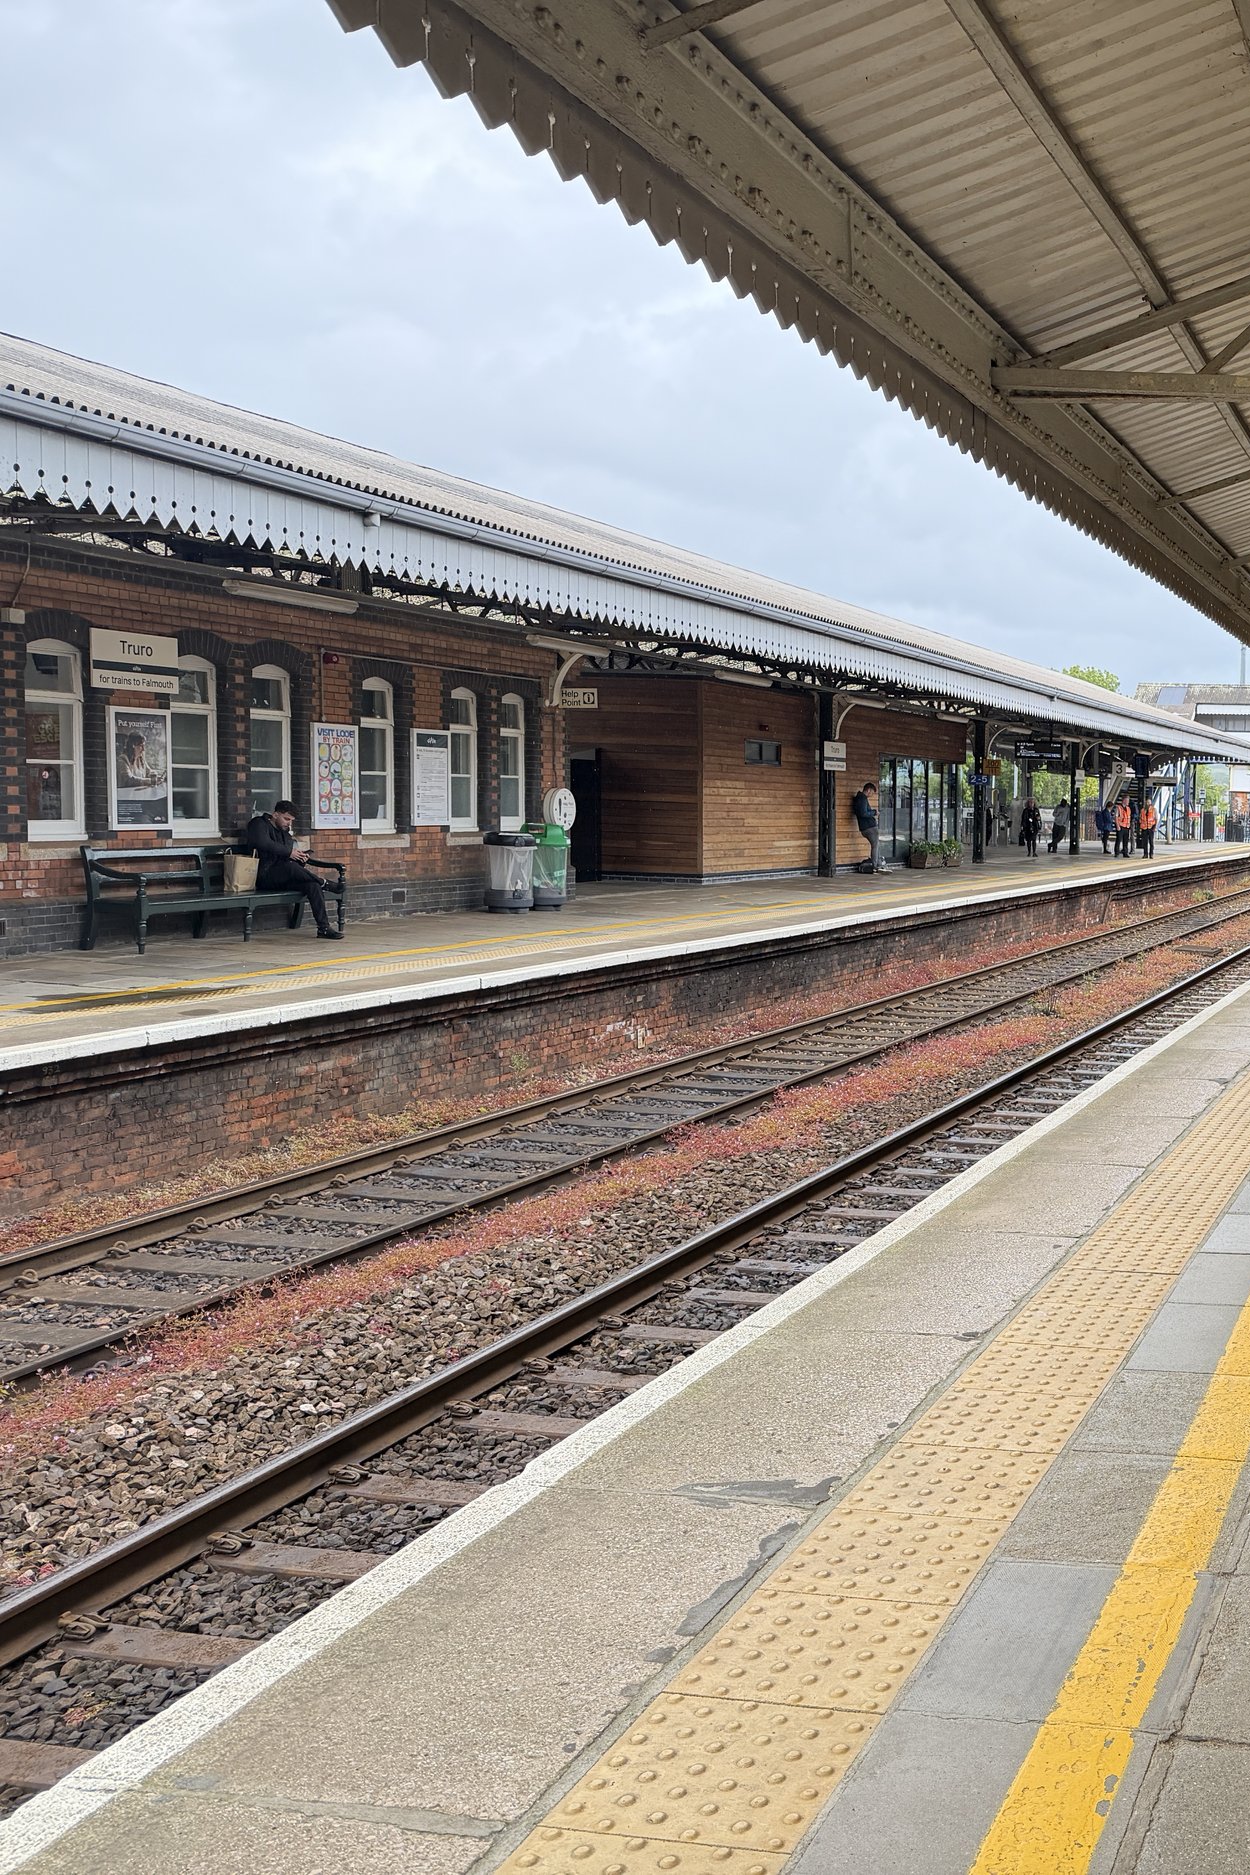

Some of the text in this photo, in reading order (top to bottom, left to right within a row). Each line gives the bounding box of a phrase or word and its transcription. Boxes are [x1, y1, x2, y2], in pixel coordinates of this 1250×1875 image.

[119, 640, 153, 657] Truro
[99, 674, 174, 689] for trains to Falmouth
[561, 690, 578, 699] Help
[117, 719, 128, 727] Put
[128, 720, 149, 728] yourself
[317, 727, 355, 738] VISIT LOOE
[1115, 764, 1123, 774] 3
